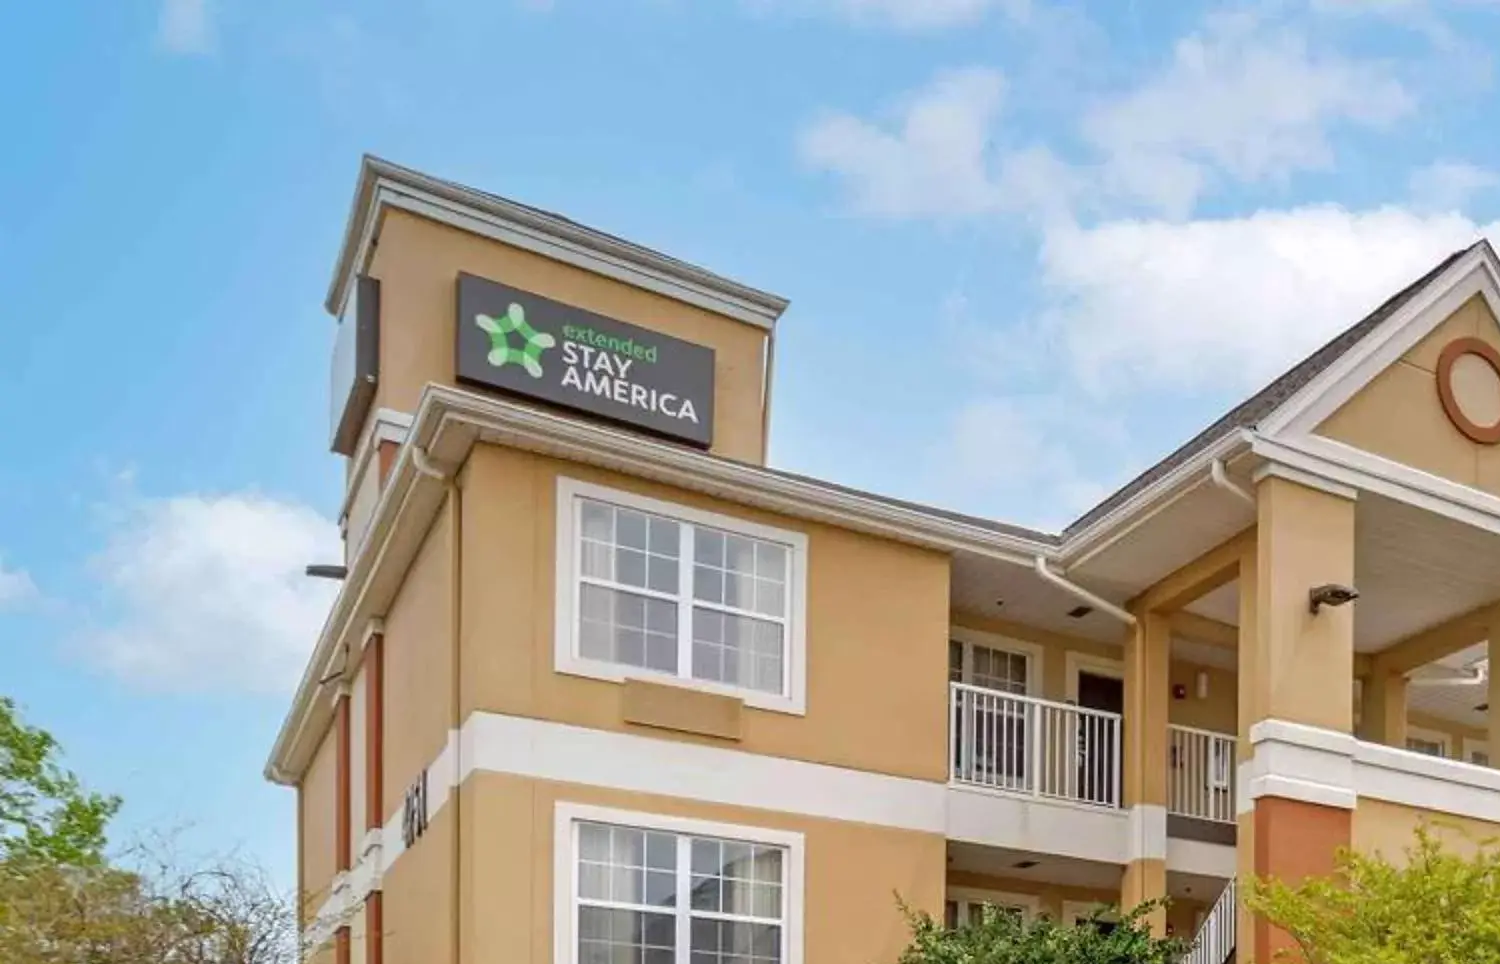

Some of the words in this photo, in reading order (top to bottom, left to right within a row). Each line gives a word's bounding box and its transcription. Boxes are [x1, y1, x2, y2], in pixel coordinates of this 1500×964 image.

[562, 324, 657, 363] extended
[562, 340, 633, 379] STAY
[561, 365, 700, 424] AMERICA
